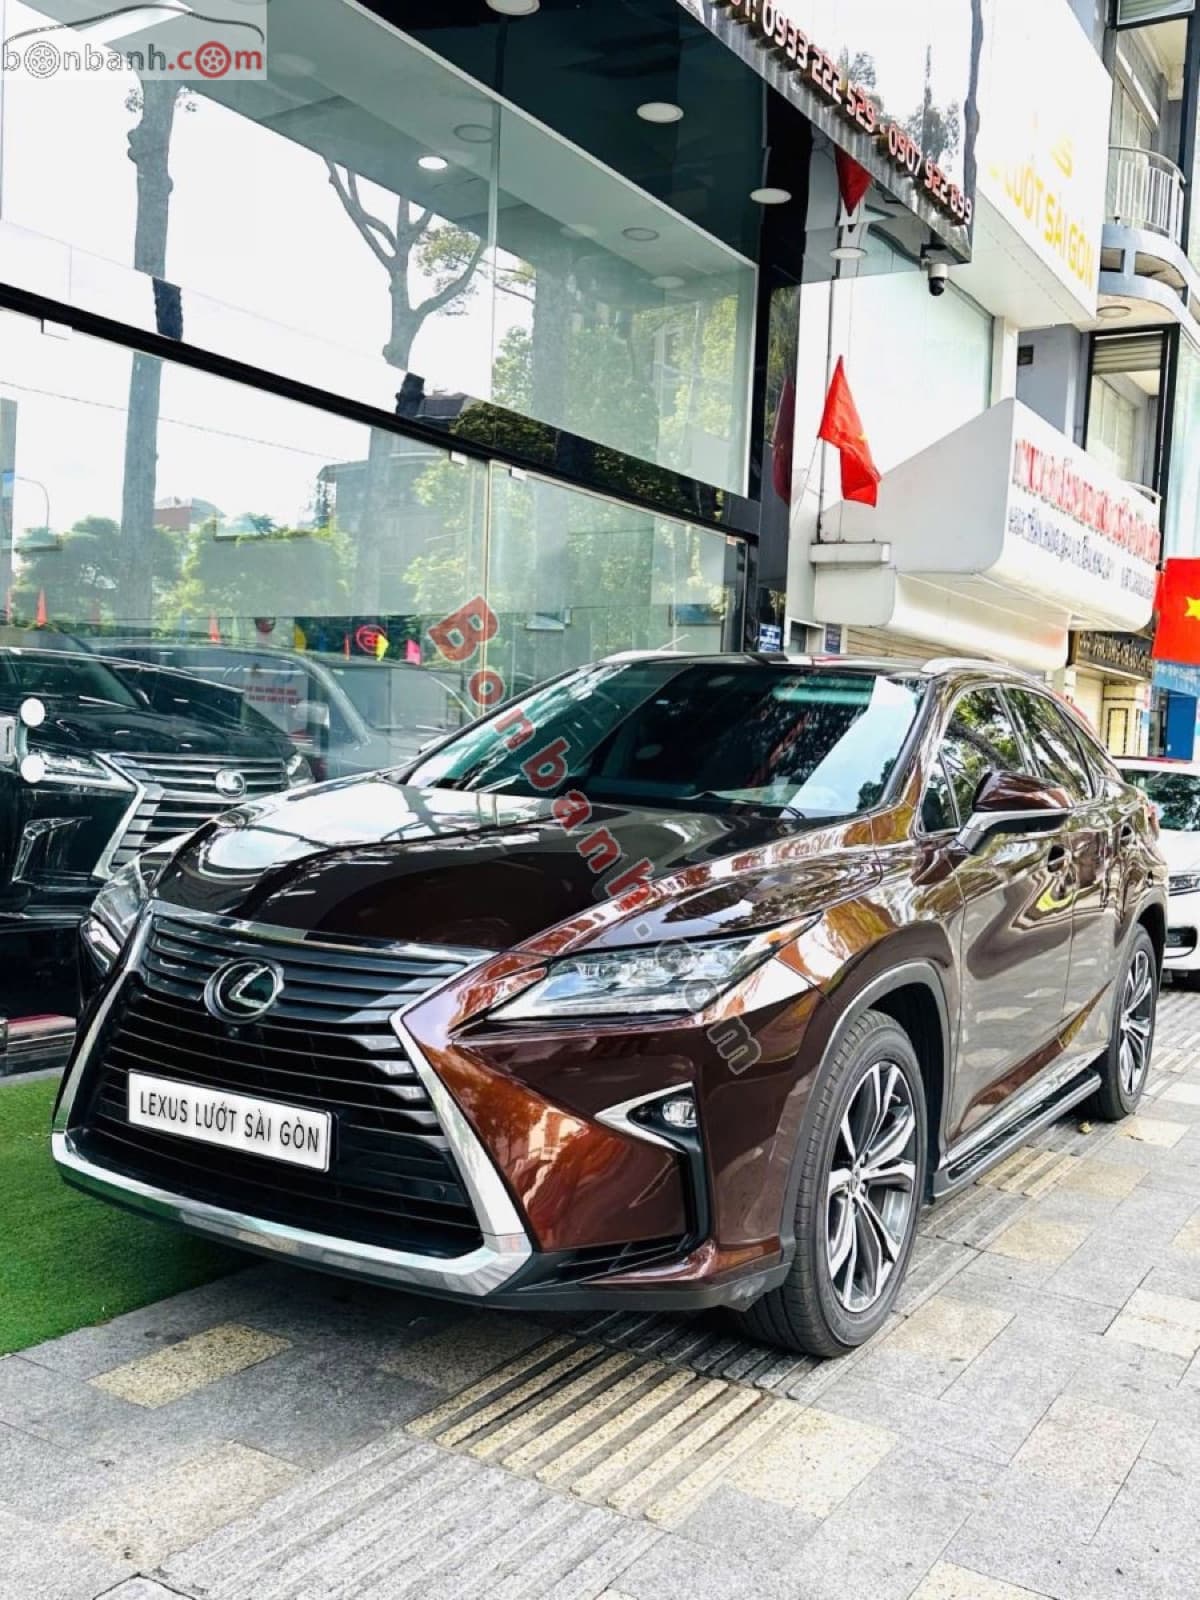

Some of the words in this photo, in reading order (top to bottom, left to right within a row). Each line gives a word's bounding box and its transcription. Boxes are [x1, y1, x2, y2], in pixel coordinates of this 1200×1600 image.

[762, 0, 808, 68] 0933
[811, 45, 842, 104] 222
[140, 1091, 188, 1123] LEXUS
[195, 1102, 237, 1134] LƯỚT
[244, 1107, 272, 1142] SÀI
[279, 1116, 320, 1153] GÒN
